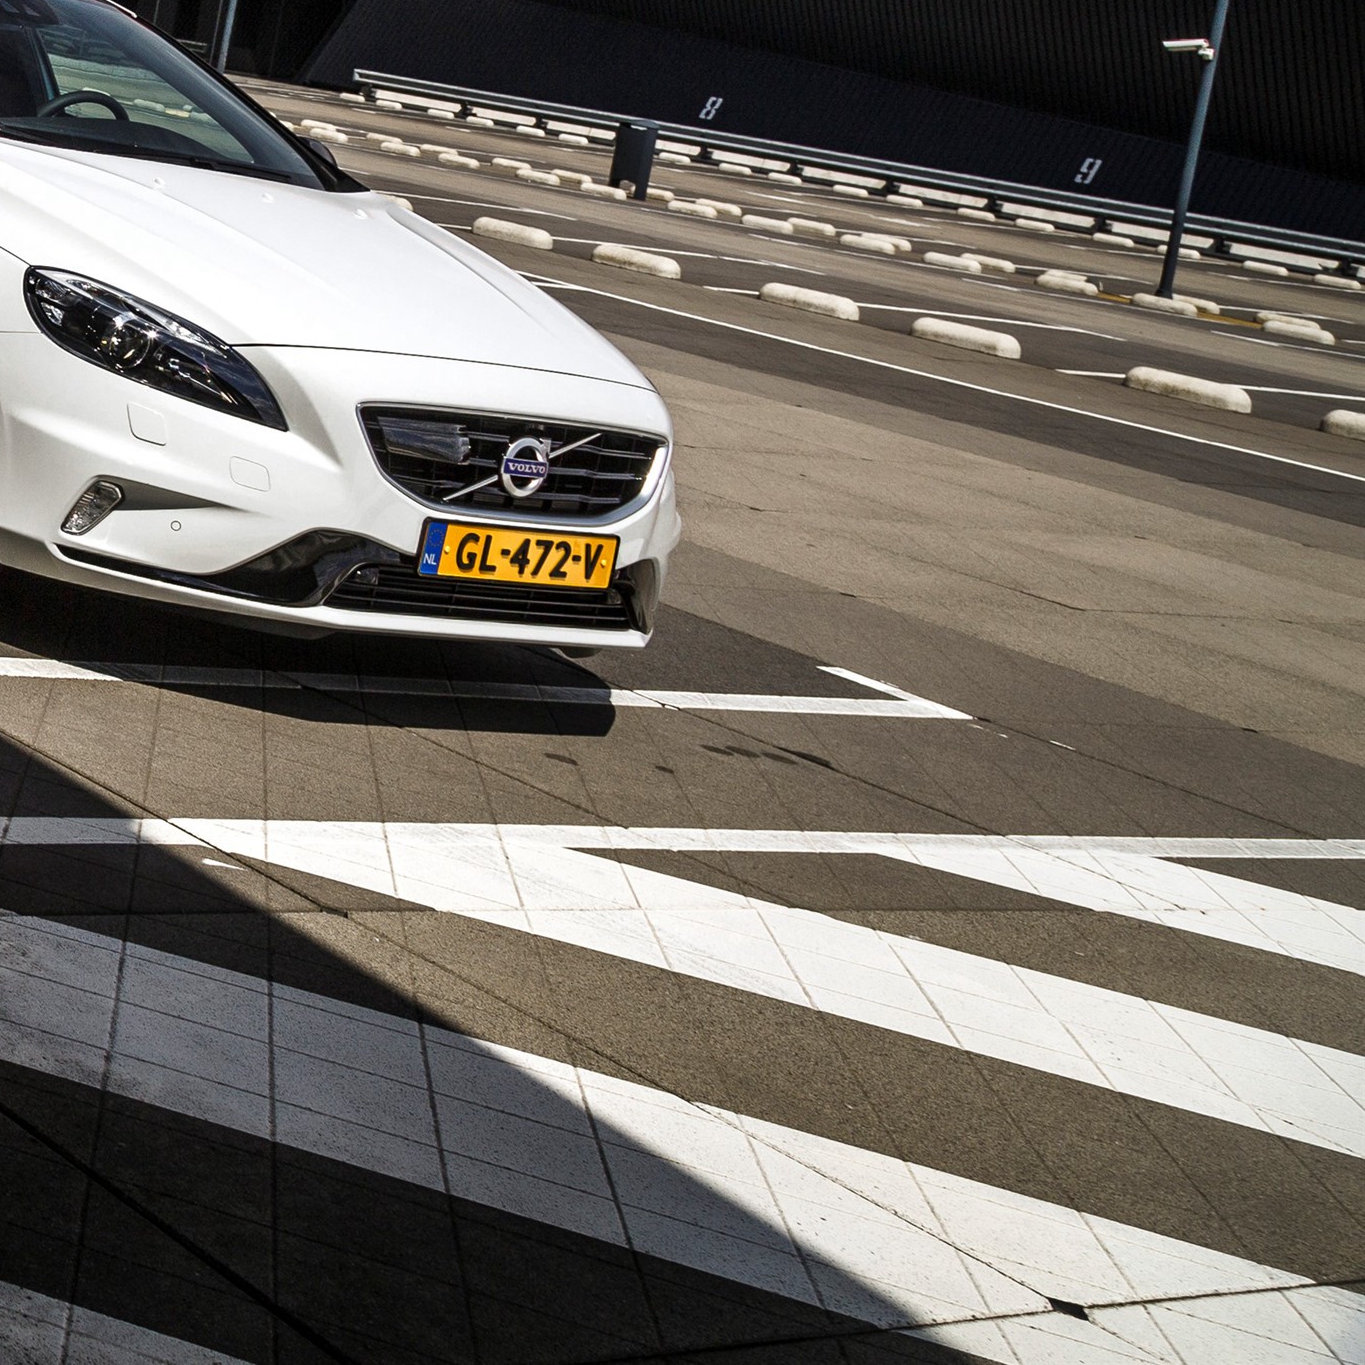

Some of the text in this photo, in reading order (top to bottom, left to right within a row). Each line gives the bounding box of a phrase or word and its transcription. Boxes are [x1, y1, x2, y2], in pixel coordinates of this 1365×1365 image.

[699, 96, 723, 120] 8
[1074, 157, 1103, 184] 9
[507, 462, 546, 474] VOLVO
[422, 553, 437, 566] NL
[455, 532, 604, 581] GL-472-V
